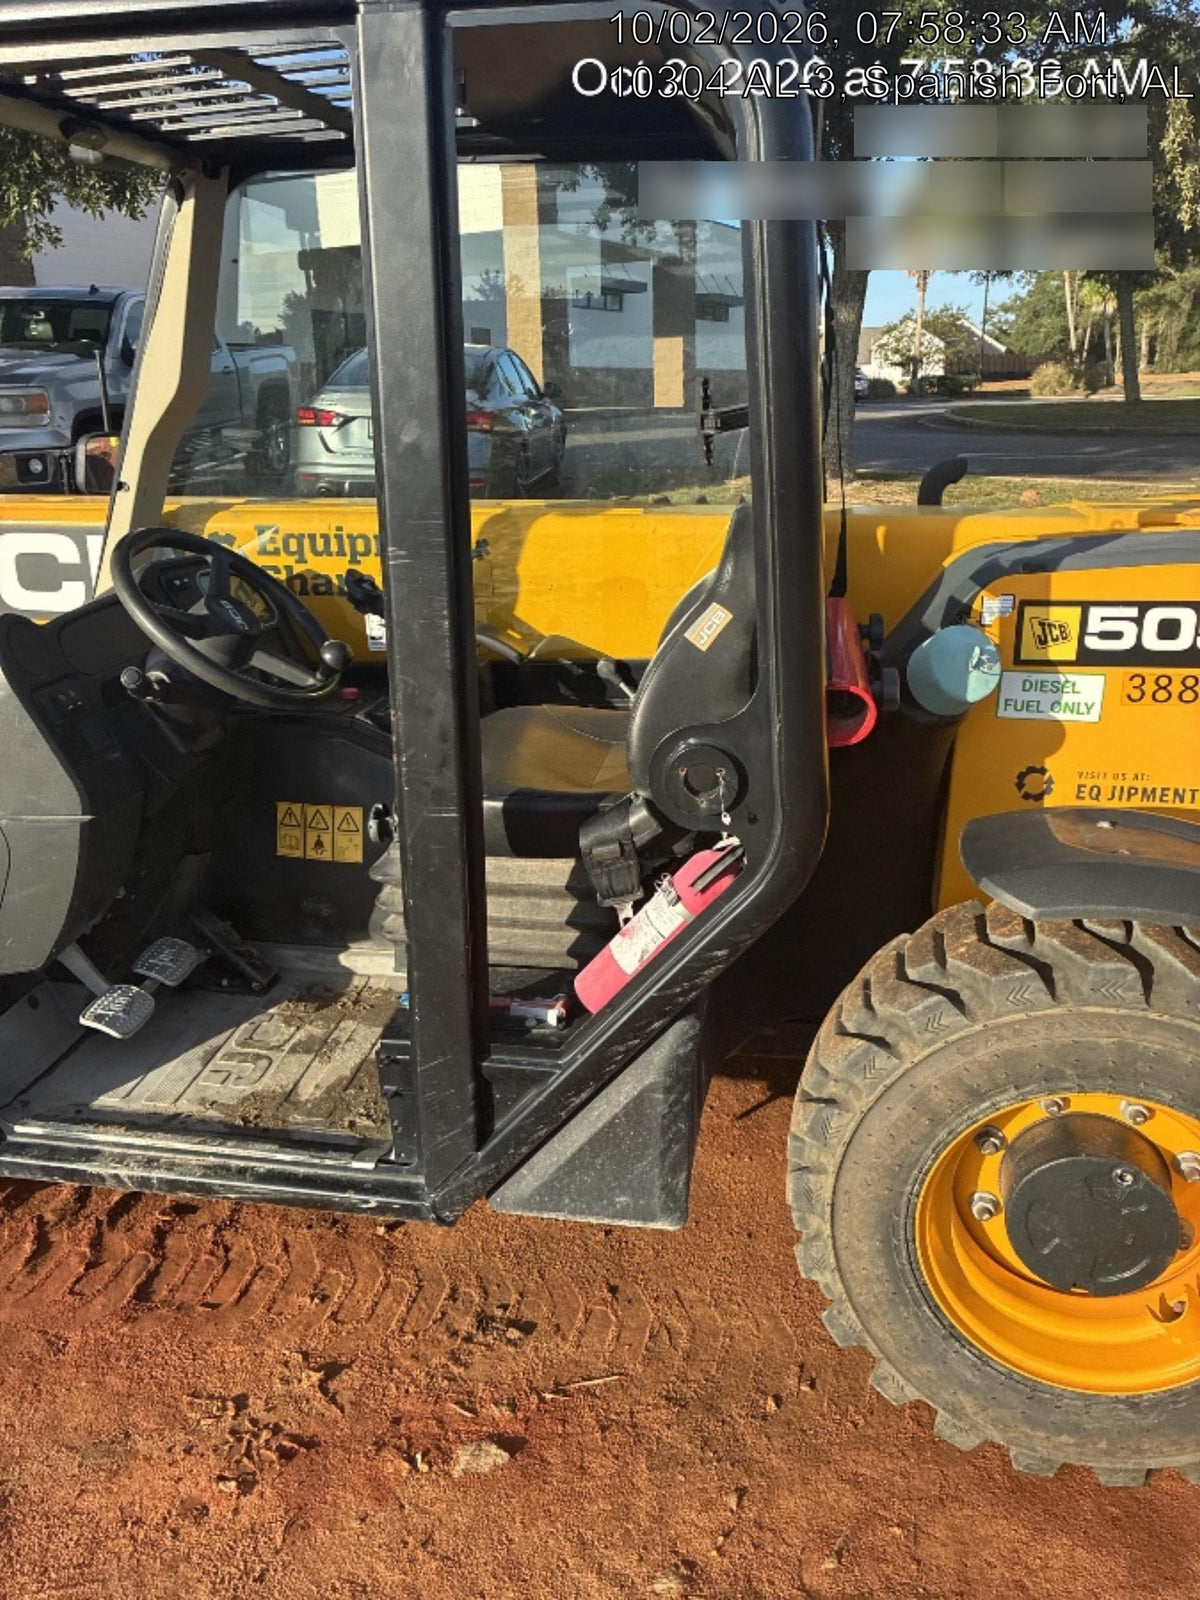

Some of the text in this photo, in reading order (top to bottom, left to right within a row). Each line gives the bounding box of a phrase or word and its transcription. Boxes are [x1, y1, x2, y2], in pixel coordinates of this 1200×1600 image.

[0, 533, 104, 613] C
[1036, 606, 1200, 651] JCB 50
[1021, 677, 1081, 695] DIESEL
[1003, 697, 1096, 716] FUEL ONLY
